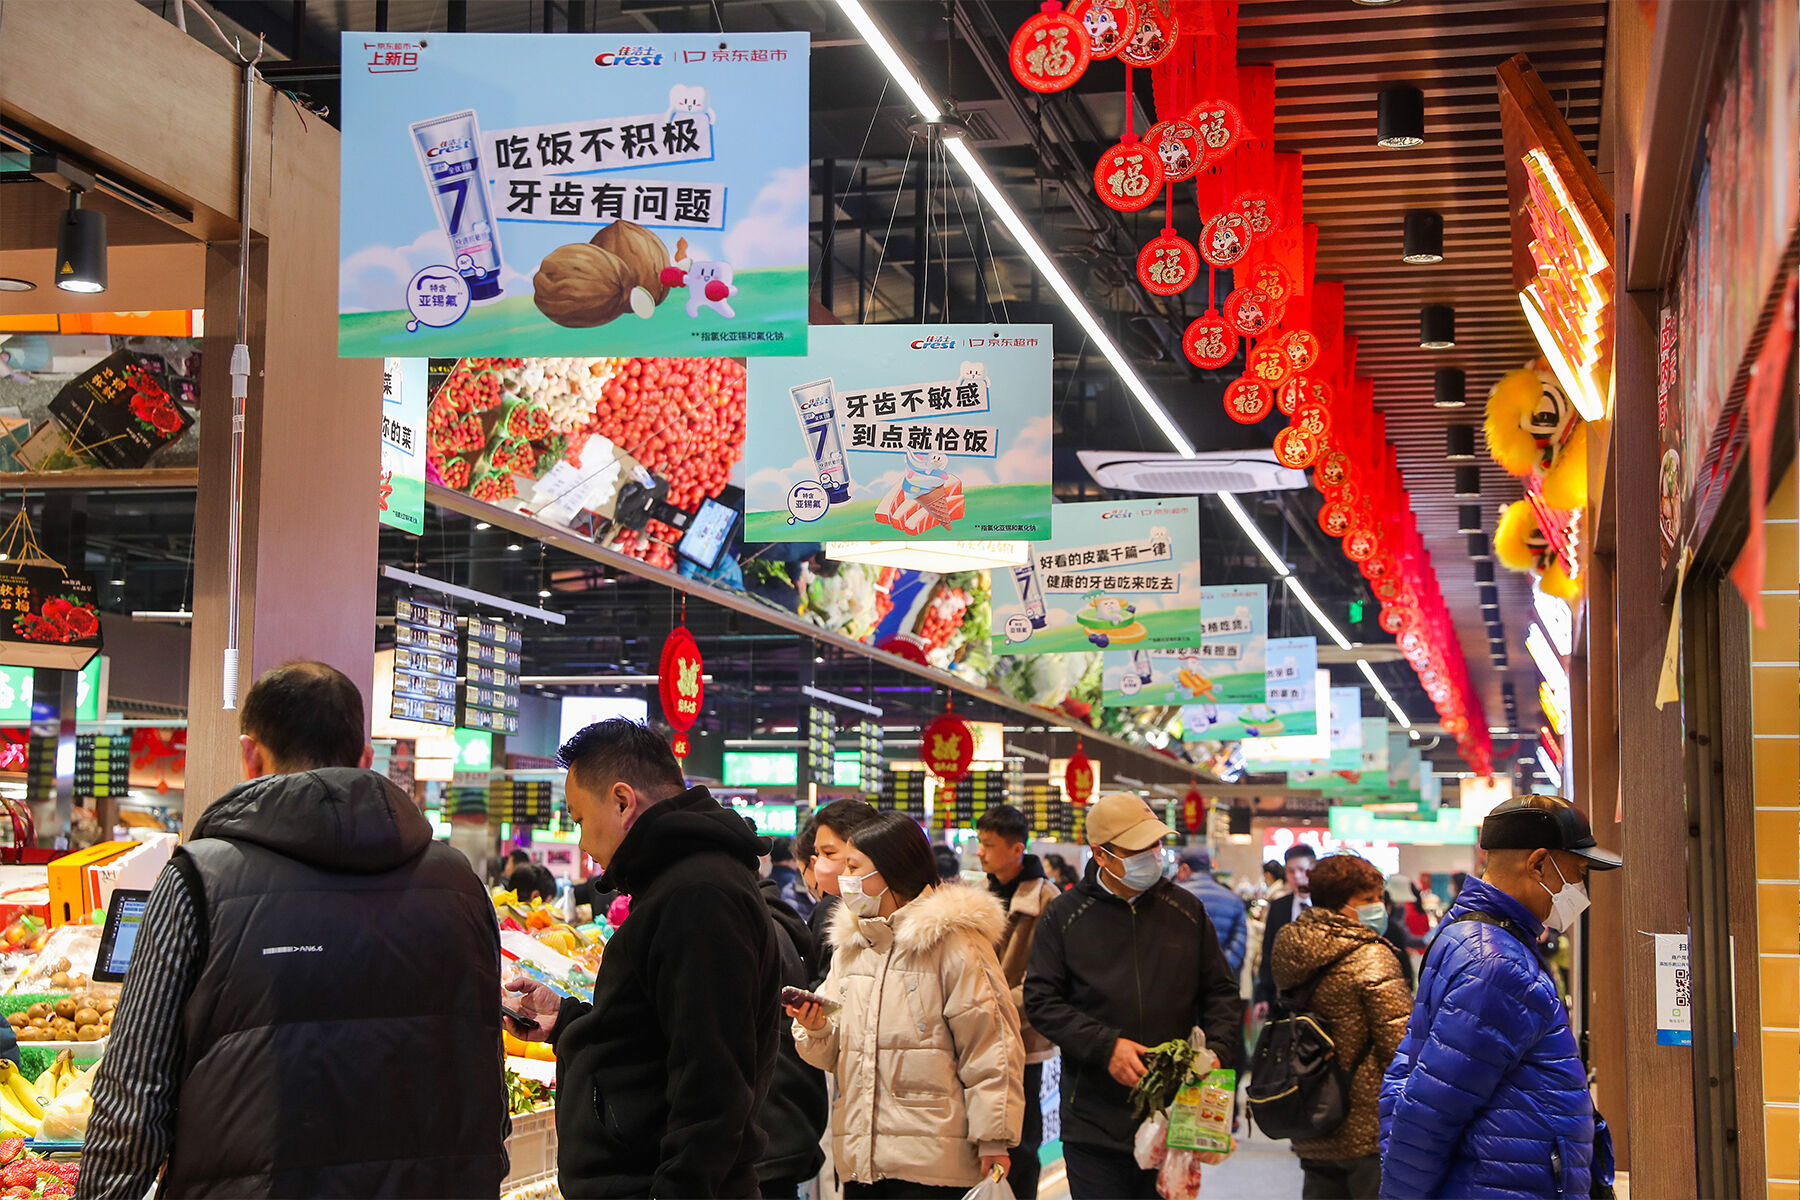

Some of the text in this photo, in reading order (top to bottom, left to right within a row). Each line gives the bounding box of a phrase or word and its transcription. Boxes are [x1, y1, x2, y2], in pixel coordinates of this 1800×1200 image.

[368, 52, 418, 67] 上新日
[594, 50, 664, 67] Crest
[618, 46, 655, 57] 佳洁士
[711, 49, 788, 63] 京东超市
[1026, 27, 1076, 77] 福
[1200, 110, 1231, 148] 福
[426, 142, 470, 158] Crest
[496, 118, 701, 170] 吃饭不积极
[1107, 154, 1150, 197] 福
[437, 178, 471, 236] 7
[506, 180, 712, 224] 牙齿有问题
[1149, 248, 1186, 285] 福
[418, 294, 458, 308] 亚锡氟
[429, 283, 447, 293] 特含
[910, 338, 956, 350] Crest
[988, 338, 1039, 348] 京东超市
[1195, 327, 1227, 358] 福
[383, 372, 393, 396] 菜
[845, 383, 981, 418] 牙齿不敏感
[1233, 384, 1263, 414] 福
[807, 423, 828, 461] 7
[852, 423, 989, 453] 到点就恰饭
[795, 499, 822, 509] 亚锡氟
[1040, 542, 1167, 570] 好看的皮囊千篇一律
[1017, 575, 1030, 601] 7
[1046, 575, 1173, 590] 健康的牙齿吃来吃去
